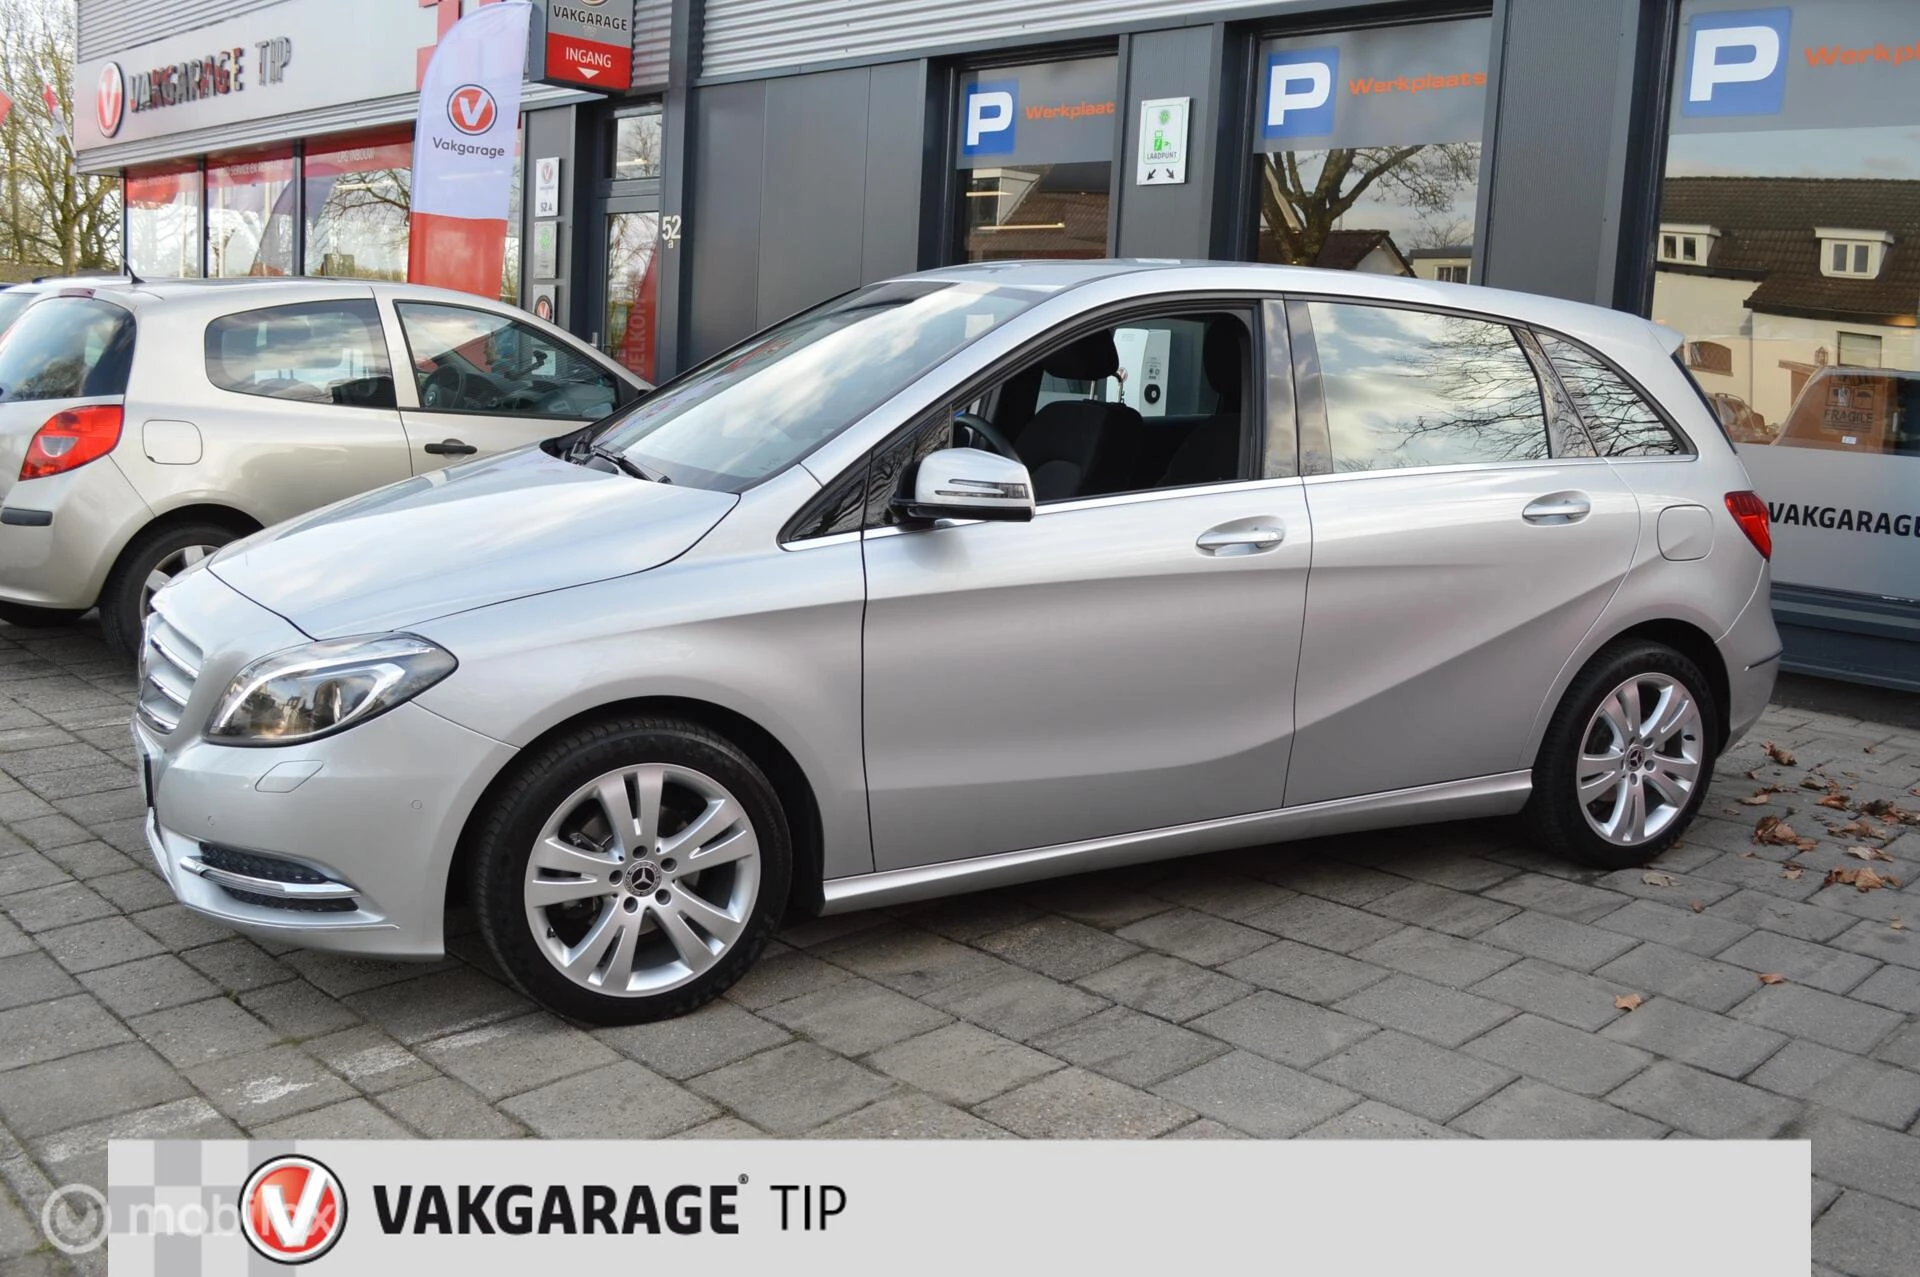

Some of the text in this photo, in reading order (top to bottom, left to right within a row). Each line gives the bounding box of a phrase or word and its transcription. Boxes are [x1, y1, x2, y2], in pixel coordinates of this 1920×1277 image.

[553, 5, 628, 31] VAKGARAGE
[565, 46, 612, 68] INGANG
[1689, 26, 1779, 102] P
[128, 47, 244, 113] VAKGARAGE
[255, 36, 292, 86] TIP
[1267, 62, 1487, 126] P Werkplaats
[966, 91, 1013, 146] P
[433, 136, 505, 159] Vakgarage
[1147, 151, 1177, 160] LAADPUNT
[662, 215, 682, 241] 52
[667, 240, 674, 249] a
[1824, 408, 1873, 424] FRAGILE
